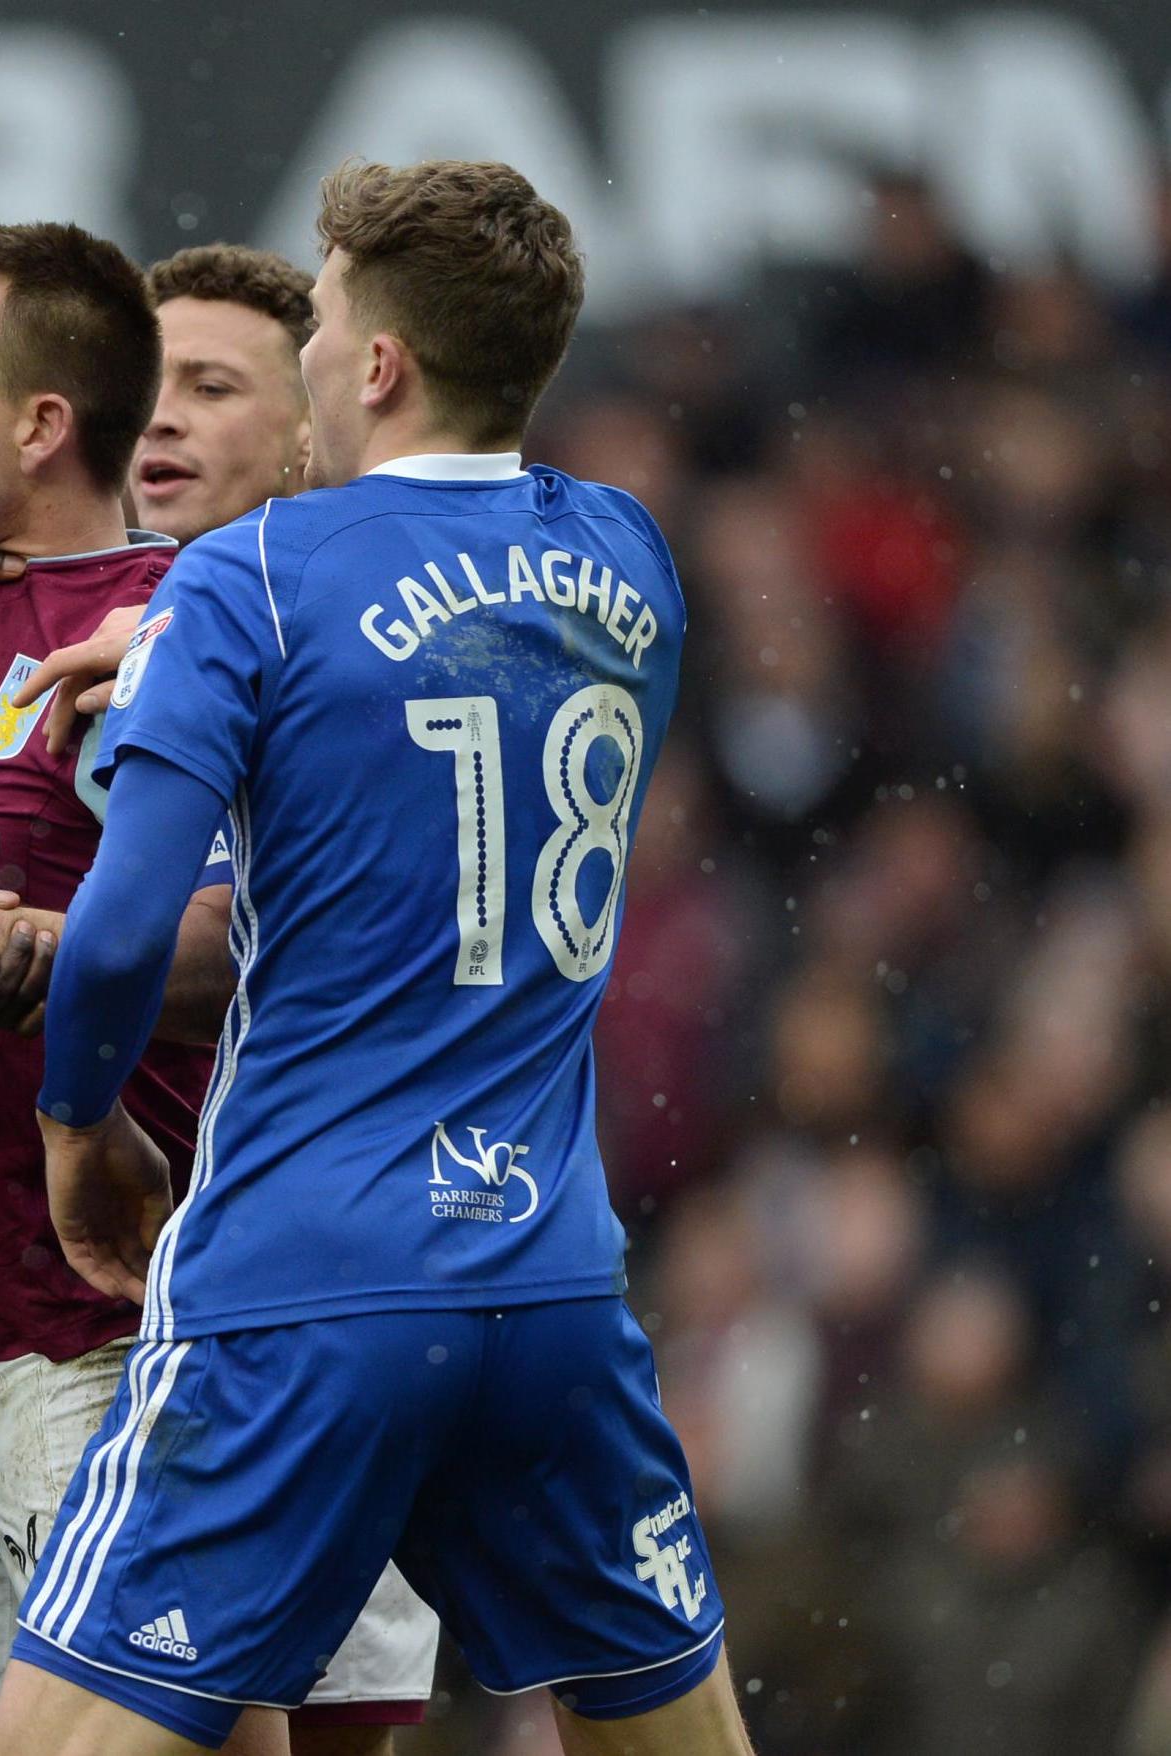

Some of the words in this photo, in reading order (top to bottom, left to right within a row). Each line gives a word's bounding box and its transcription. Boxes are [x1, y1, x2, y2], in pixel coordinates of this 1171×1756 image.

[359, 544, 658, 672] GALLAGHER
[405, 683, 644, 985] 18
[468, 965, 486, 976] EFL
[429, 1190, 506, 1208] BARRISTERS
[431, 1204, 503, 1223] CHAMBERS
[128, 1631, 198, 1662] adidas
